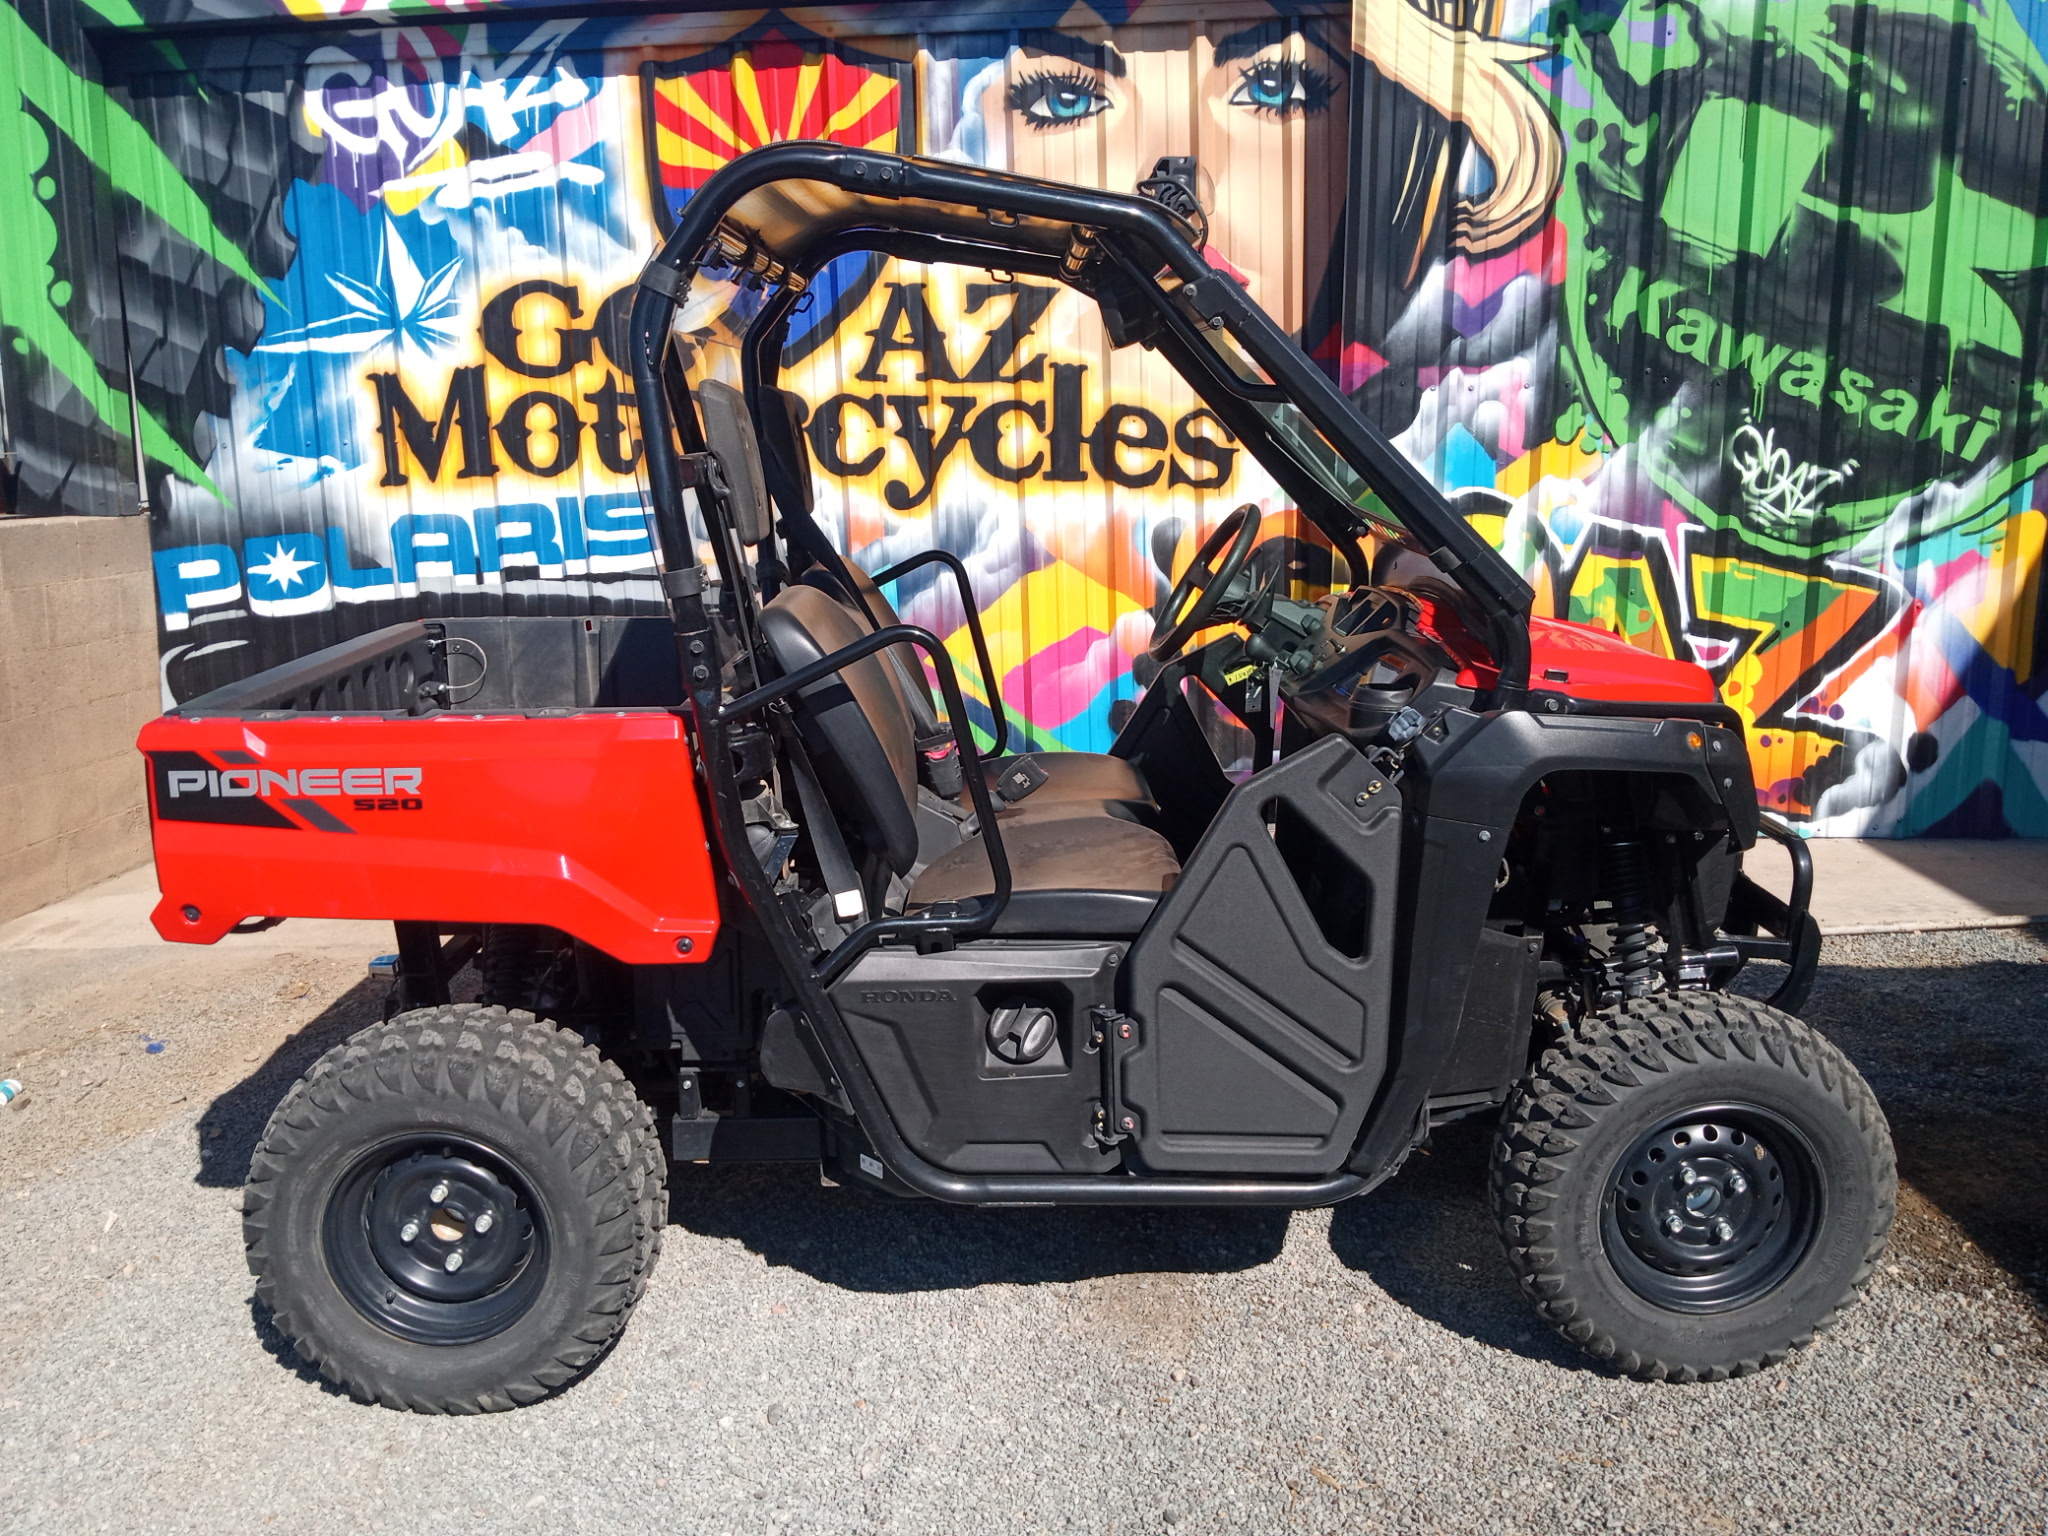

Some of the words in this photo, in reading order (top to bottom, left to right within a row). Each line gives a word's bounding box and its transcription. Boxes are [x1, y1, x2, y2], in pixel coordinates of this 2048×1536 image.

[855, 281, 1062, 384] AZ
[1604, 266, 2001, 463] Kawasaki
[153, 490, 662, 631] POLARIS
[166, 767, 424, 799] PIONEER
[353, 798, 424, 812] 520
[859, 988, 958, 1003] HONDA
